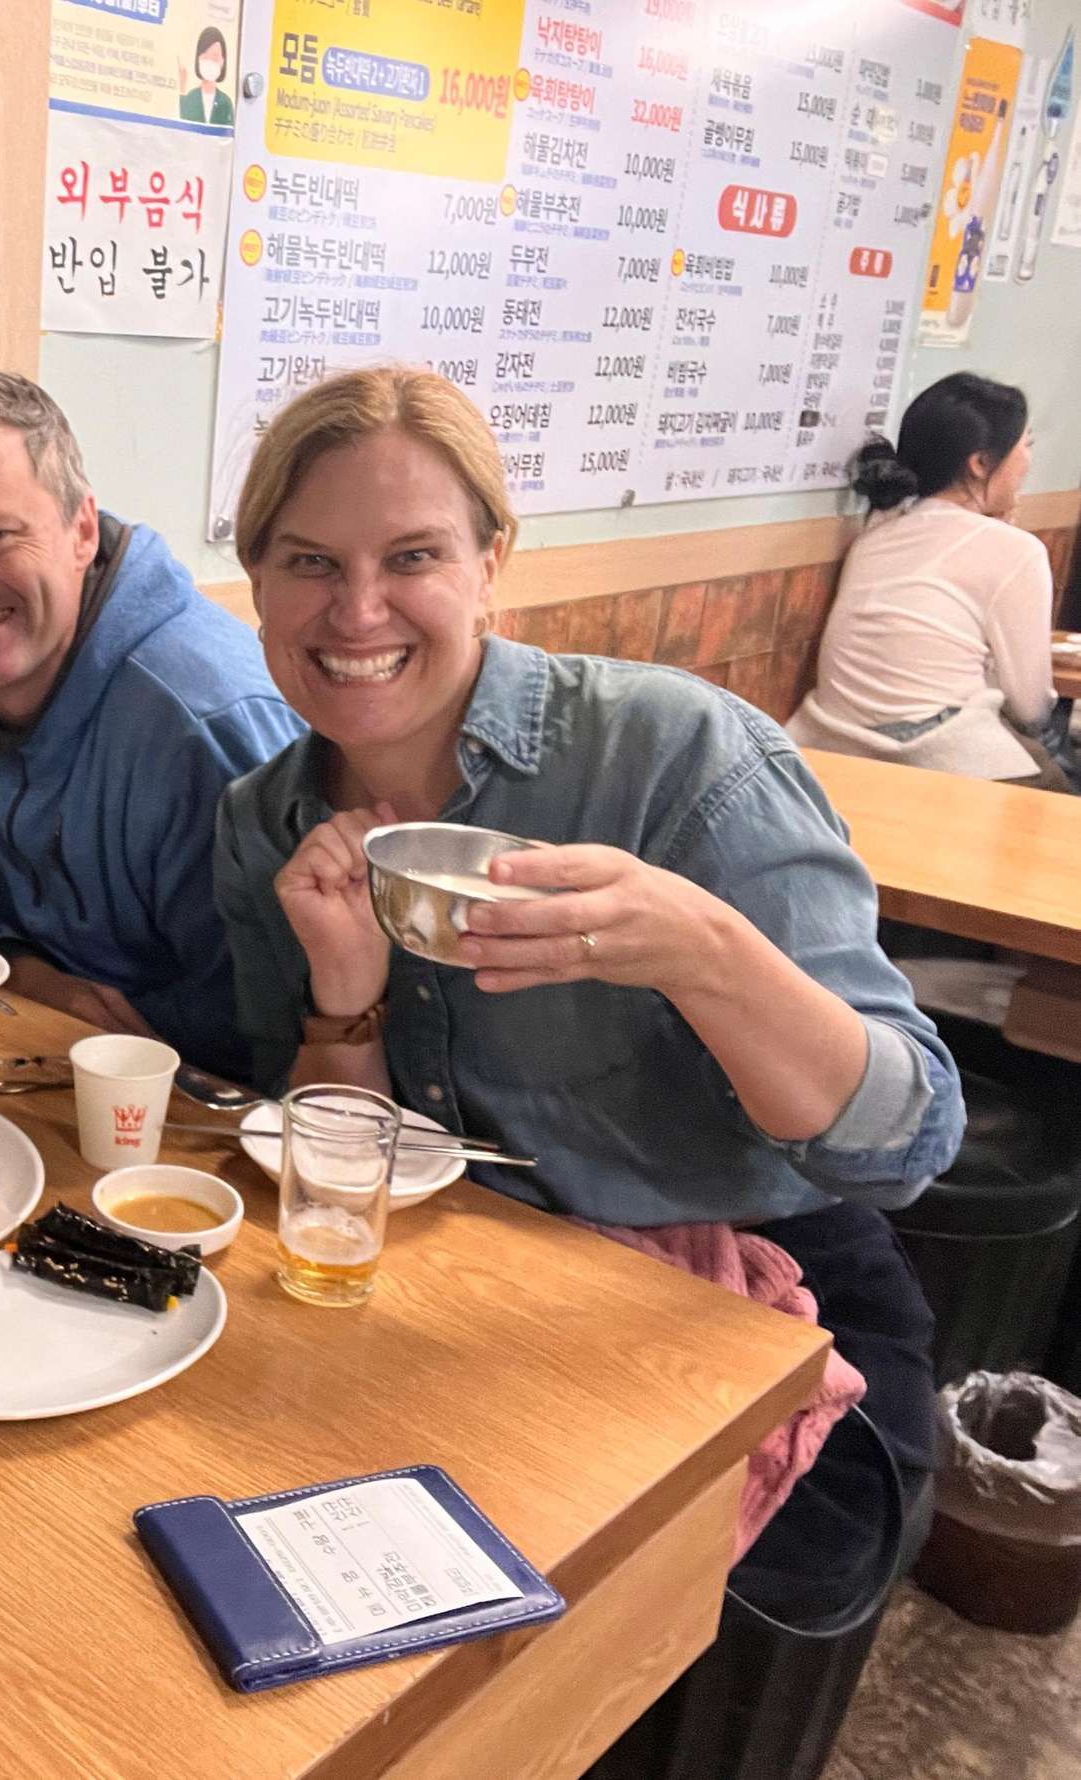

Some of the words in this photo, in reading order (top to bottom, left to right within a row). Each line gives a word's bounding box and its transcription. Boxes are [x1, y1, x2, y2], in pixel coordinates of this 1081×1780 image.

[537, 16, 602, 60] 낙지탕탕이
[279, 32, 319, 85] 모듬
[438, 66, 511, 119] 16,000원
[631, 99, 683, 133] 32,000원
[524, 132, 588, 169] 해물김치전
[624, 153, 675, 183] 10,000원
[271, 169, 359, 210] 녹두빈대떡
[443, 193, 498, 225] 7,000원
[517, 189, 581, 223] 해물부추전
[617, 205, 669, 233] 10,000원
[49, 237, 117, 297] 반입
[142, 246, 210, 302] 불가
[267, 231, 387, 272] 해물녹두빈대떡
[427, 250, 492, 280] 12,000원
[510, 245, 549, 274] 두부전
[617, 256, 661, 283] 7,000원
[262, 297, 381, 331] 고기녹두빈대떡
[421, 305, 485, 334] 10,000원
[503, 299, 542, 327] 동태전
[602, 306, 653, 333] 12,000원
[495, 352, 535, 379] 감자전
[595, 354, 646, 381] 12,000원
[587, 402, 639, 429] 12,000원
[503, 451, 546, 479] 어무침
[579, 449, 631, 476] 15,000원
